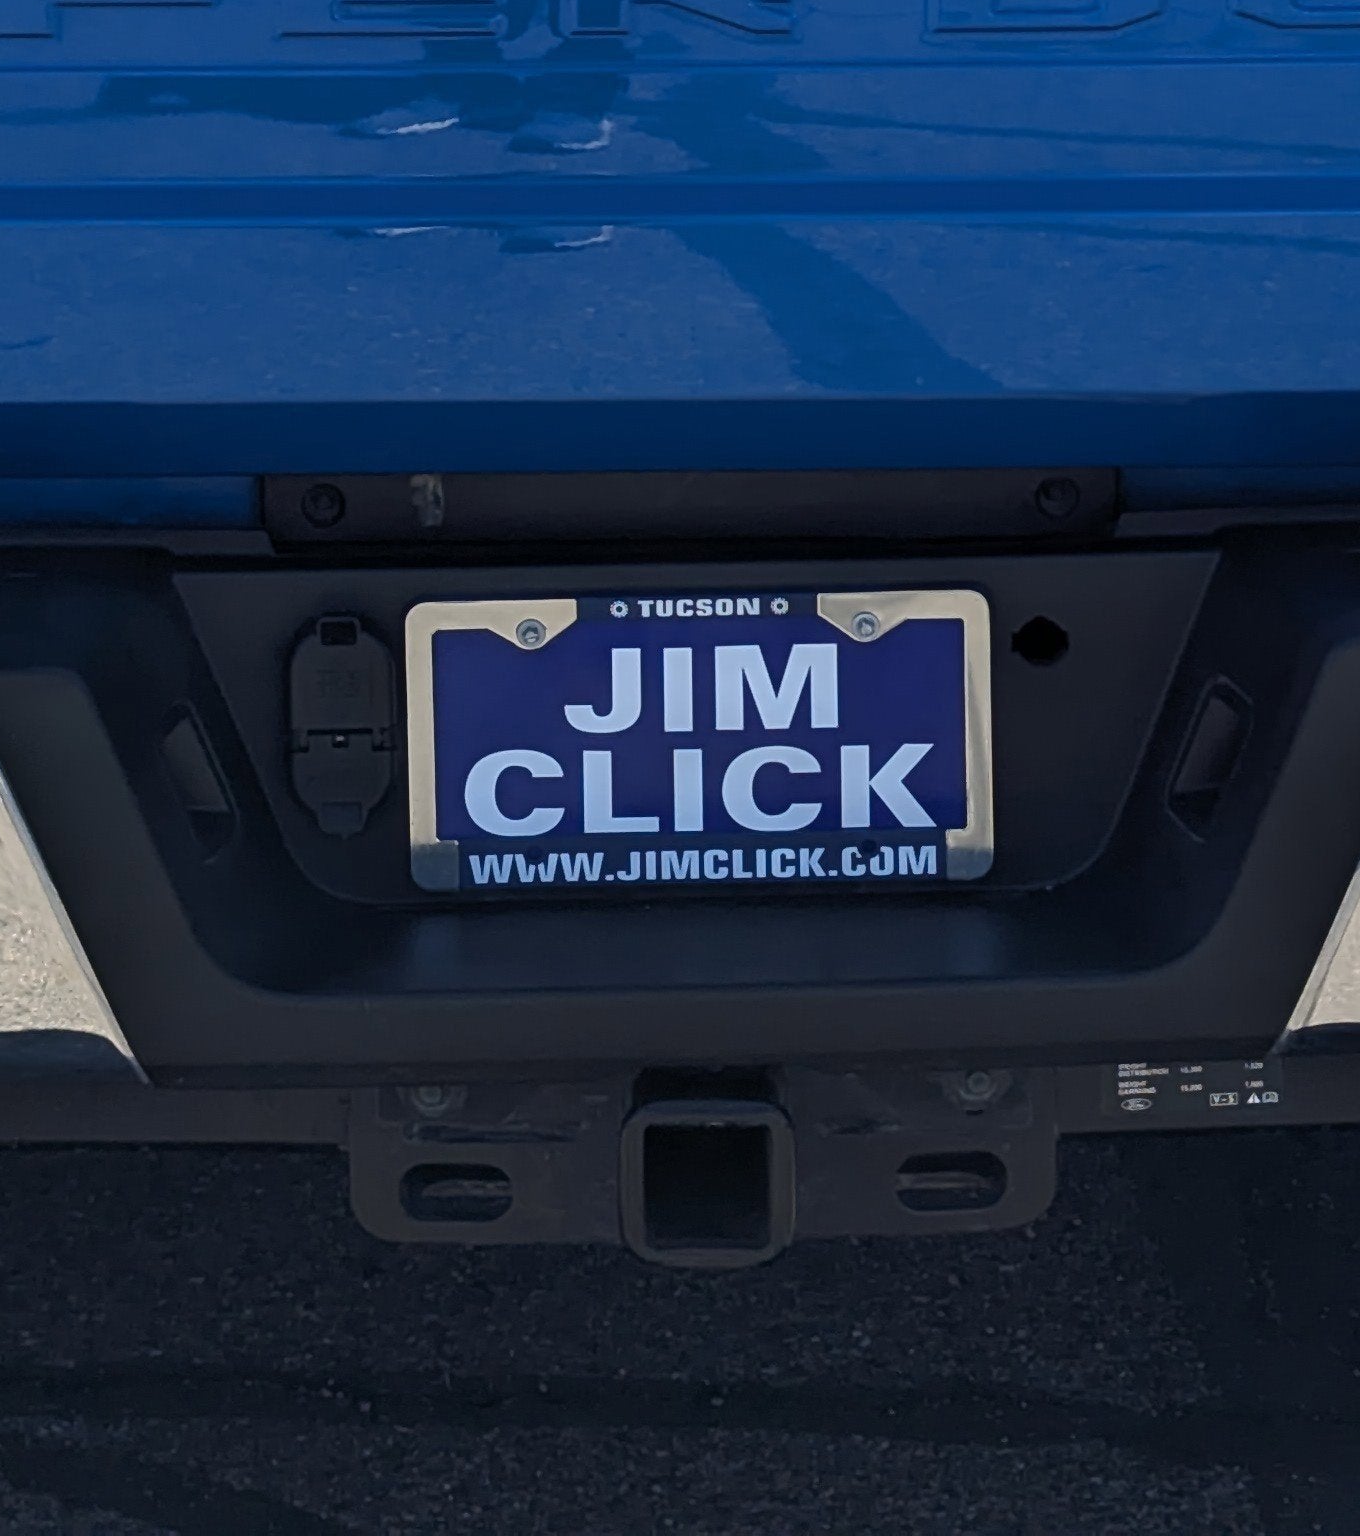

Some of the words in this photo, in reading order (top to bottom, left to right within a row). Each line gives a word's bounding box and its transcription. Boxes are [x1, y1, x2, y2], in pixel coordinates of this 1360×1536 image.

[637, 597, 761, 618] TUCSON
[564, 643, 839, 734] JIM
[464, 743, 937, 837] CLICK
[469, 845, 938, 885] WWW.JIMCLICK.COM
